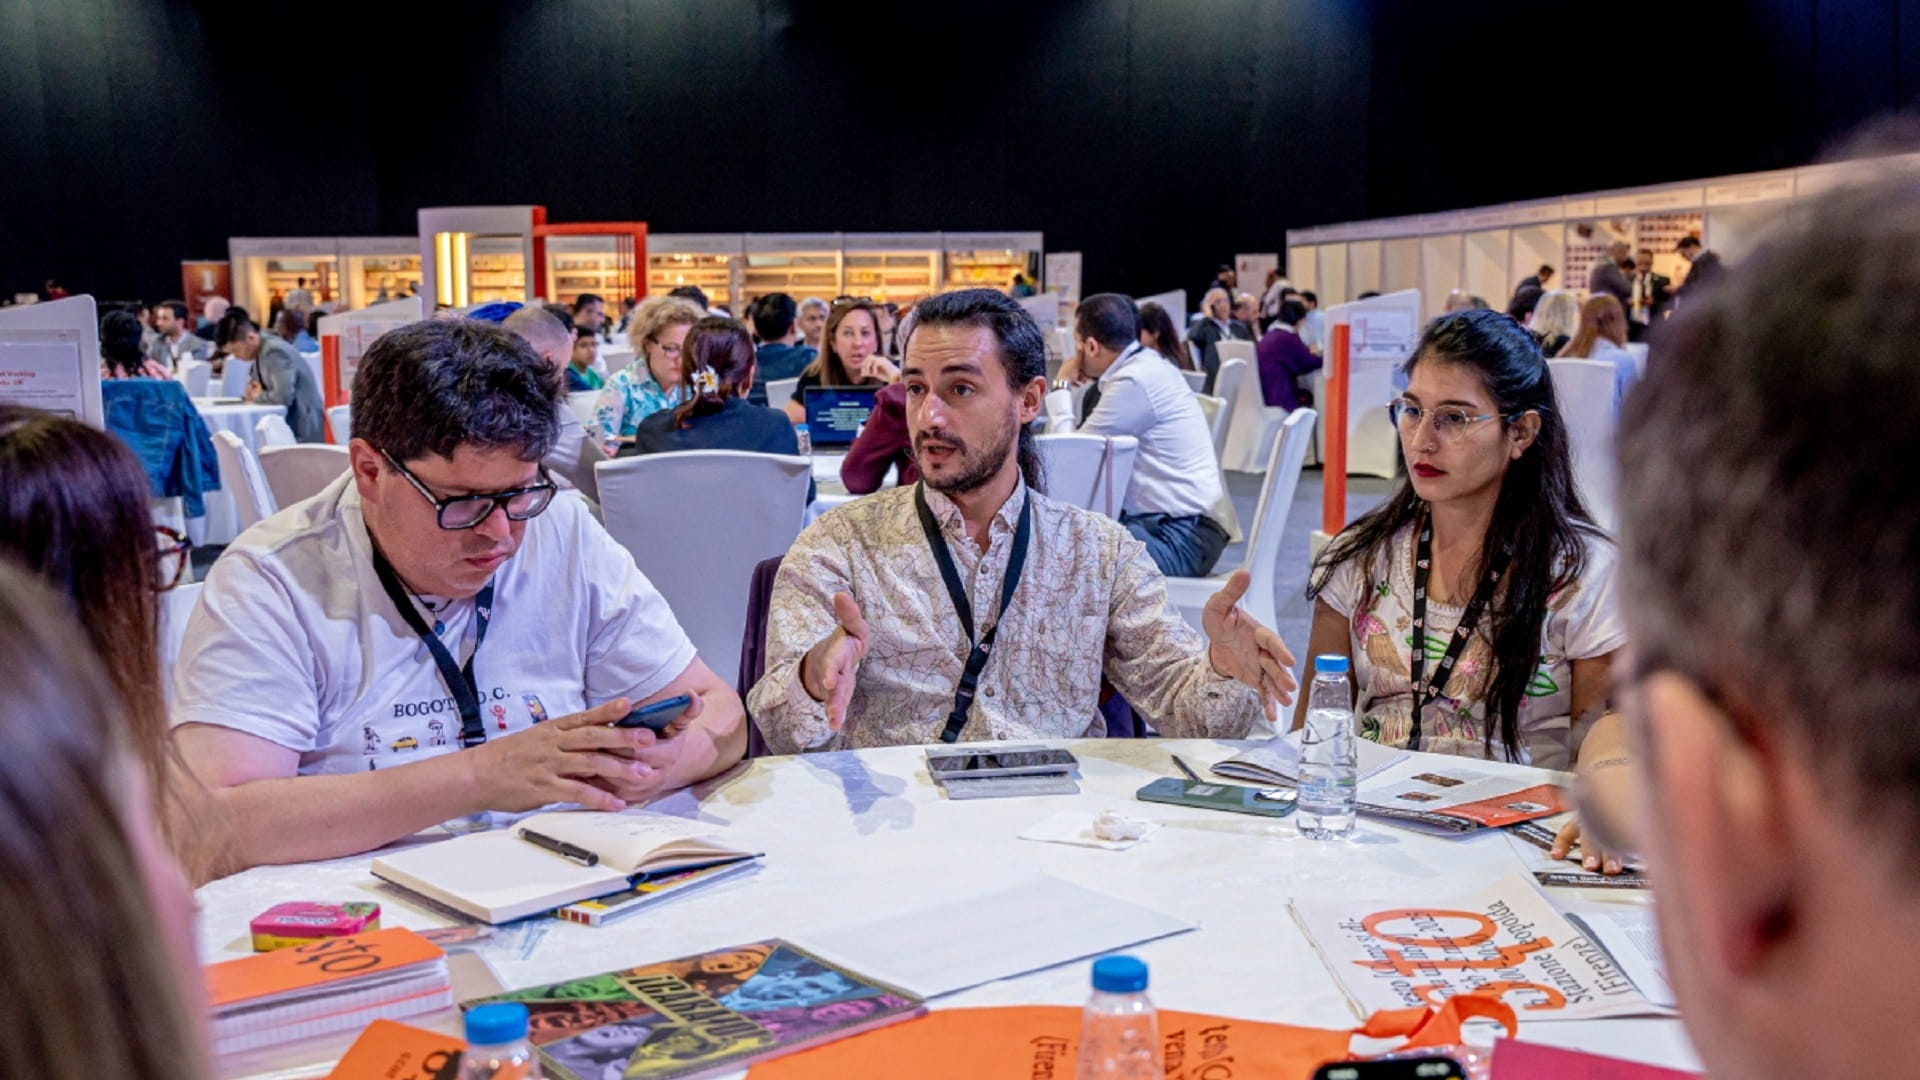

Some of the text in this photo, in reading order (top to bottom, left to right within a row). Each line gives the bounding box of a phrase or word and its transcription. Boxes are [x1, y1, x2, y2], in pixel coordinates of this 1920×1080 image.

[394, 696, 456, 718] BOGOT
[1484, 900, 1544, 954] Leopolda
[1533, 953, 1594, 1003] Stazione
[1560, 936, 1634, 996] (Firenze)
